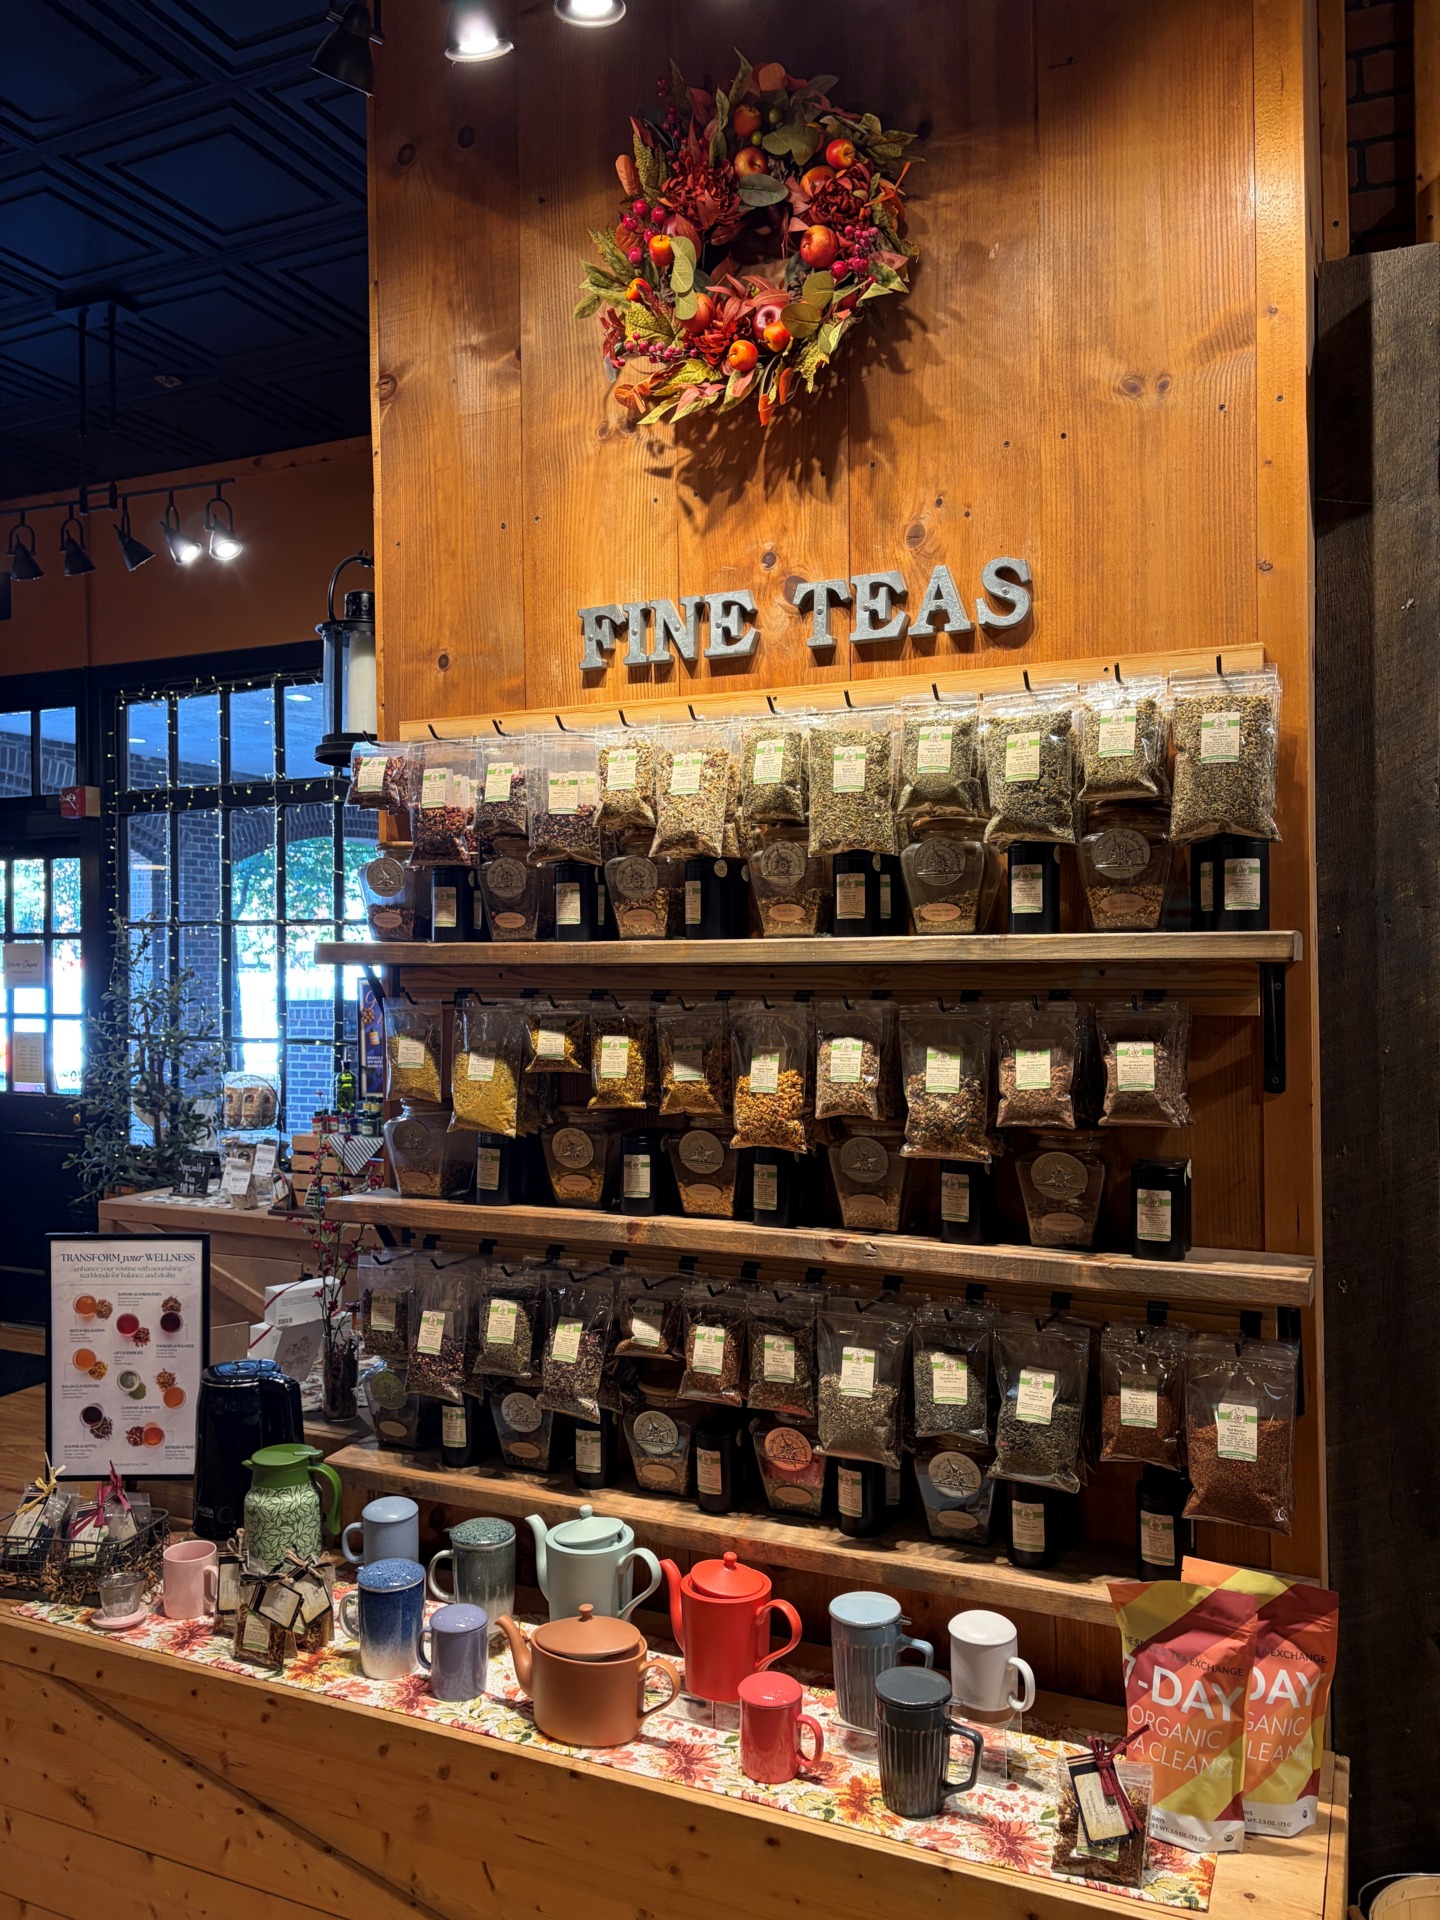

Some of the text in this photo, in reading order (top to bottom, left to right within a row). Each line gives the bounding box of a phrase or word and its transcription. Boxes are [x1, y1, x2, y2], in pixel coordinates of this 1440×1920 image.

[577, 556, 1033, 671] FINE TEAS
[178, 1158, 206, 1177] Specialty
[60, 1253, 196, 1264] TRANSFORM your WELLNESS
[150, 1265, 183, 1273] nourishing
[157, 1271, 177, 1280] vitality
[1124, 1632, 1134, 1647] HE
[1170, 1649, 1187, 1664] TEA
[1189, 1657, 1244, 1677] EXCHANGE
[1270, 1648, 1328, 1664] EXCHANGE
[1250, 1665, 1327, 1709] DAY
[1129, 1704, 1223, 1750] ORGANIC
[1246, 1711, 1305, 1737] GANIC
[1151, 1814, 1166, 1825] DAYS
[1159, 1825, 1170, 1833] WT.
[1170, 1828, 1179, 1836] 2.5
